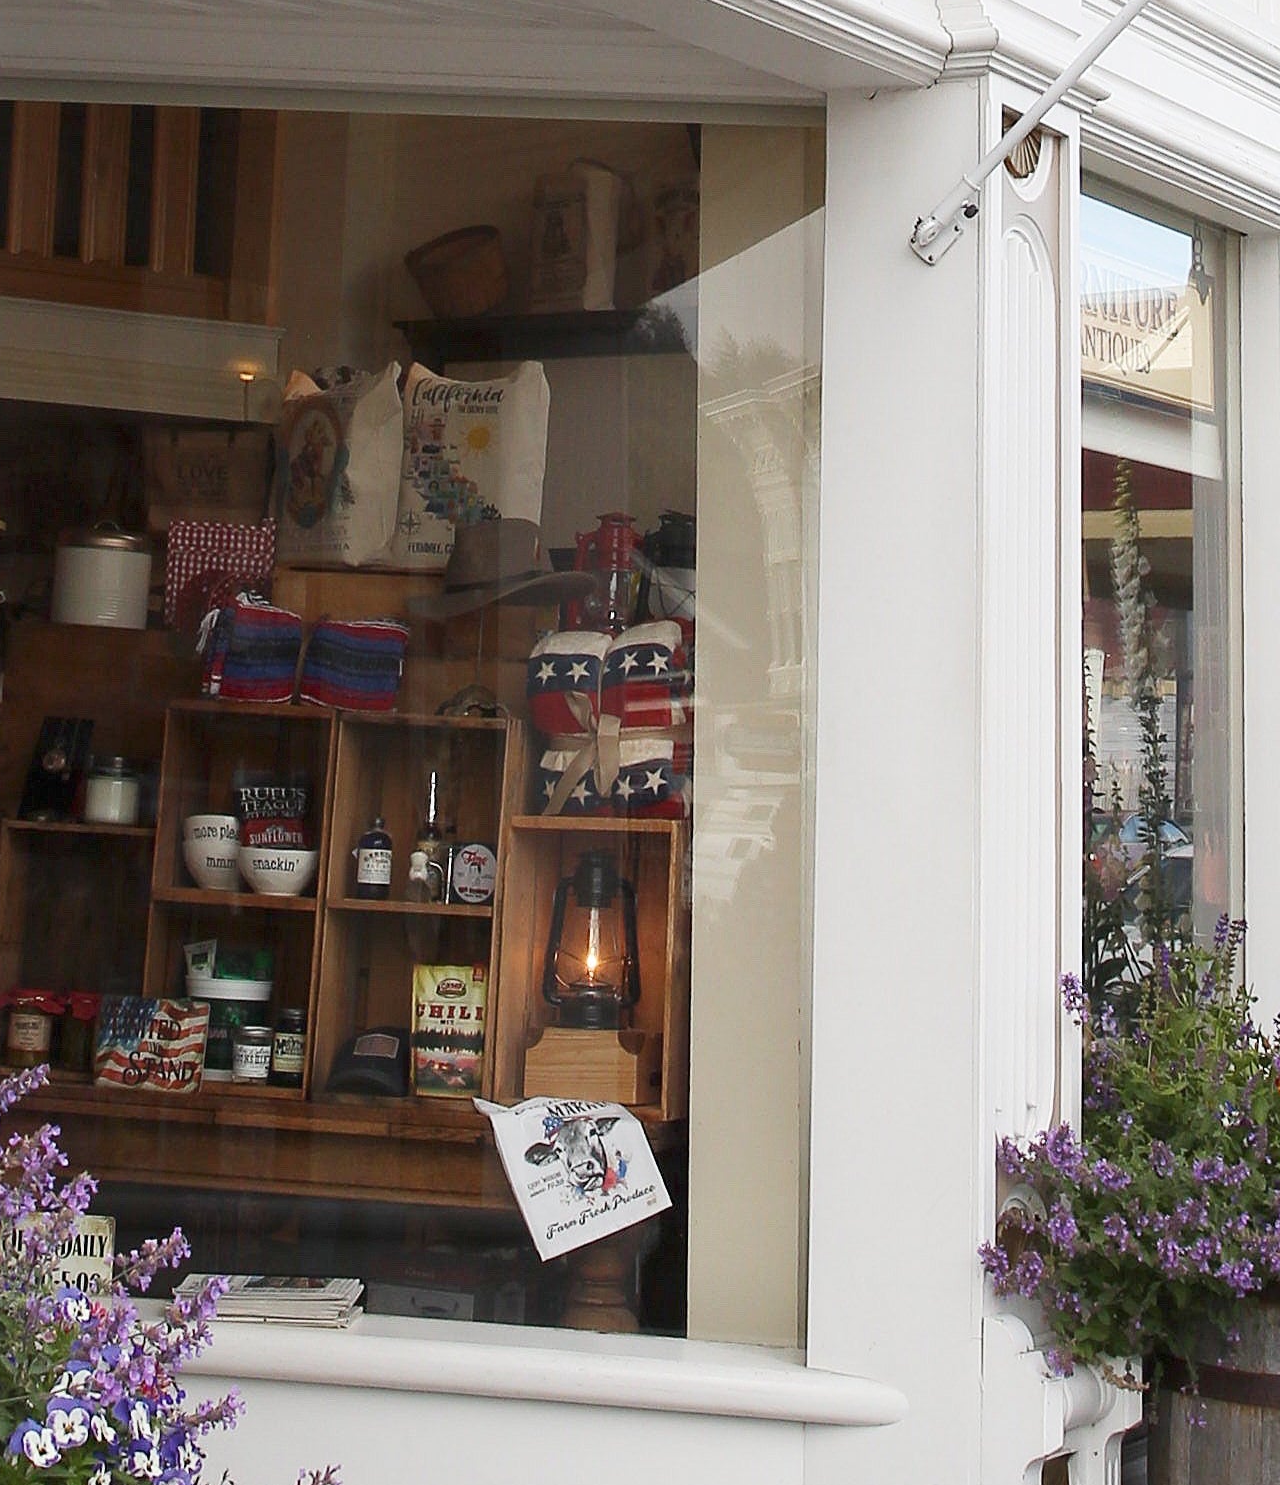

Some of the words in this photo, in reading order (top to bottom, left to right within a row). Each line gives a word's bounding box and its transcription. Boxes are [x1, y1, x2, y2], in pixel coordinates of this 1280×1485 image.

[192, 824, 218, 839] more
[252, 859, 300, 873] snackin'
[416, 1004, 484, 1020] CHILI
[122, 1051, 201, 1086] STAND
[578, 1202, 611, 1226] Fresh
[612, 1183, 656, 1212] Produce
[55, 1233, 108, 1259] DAILY
